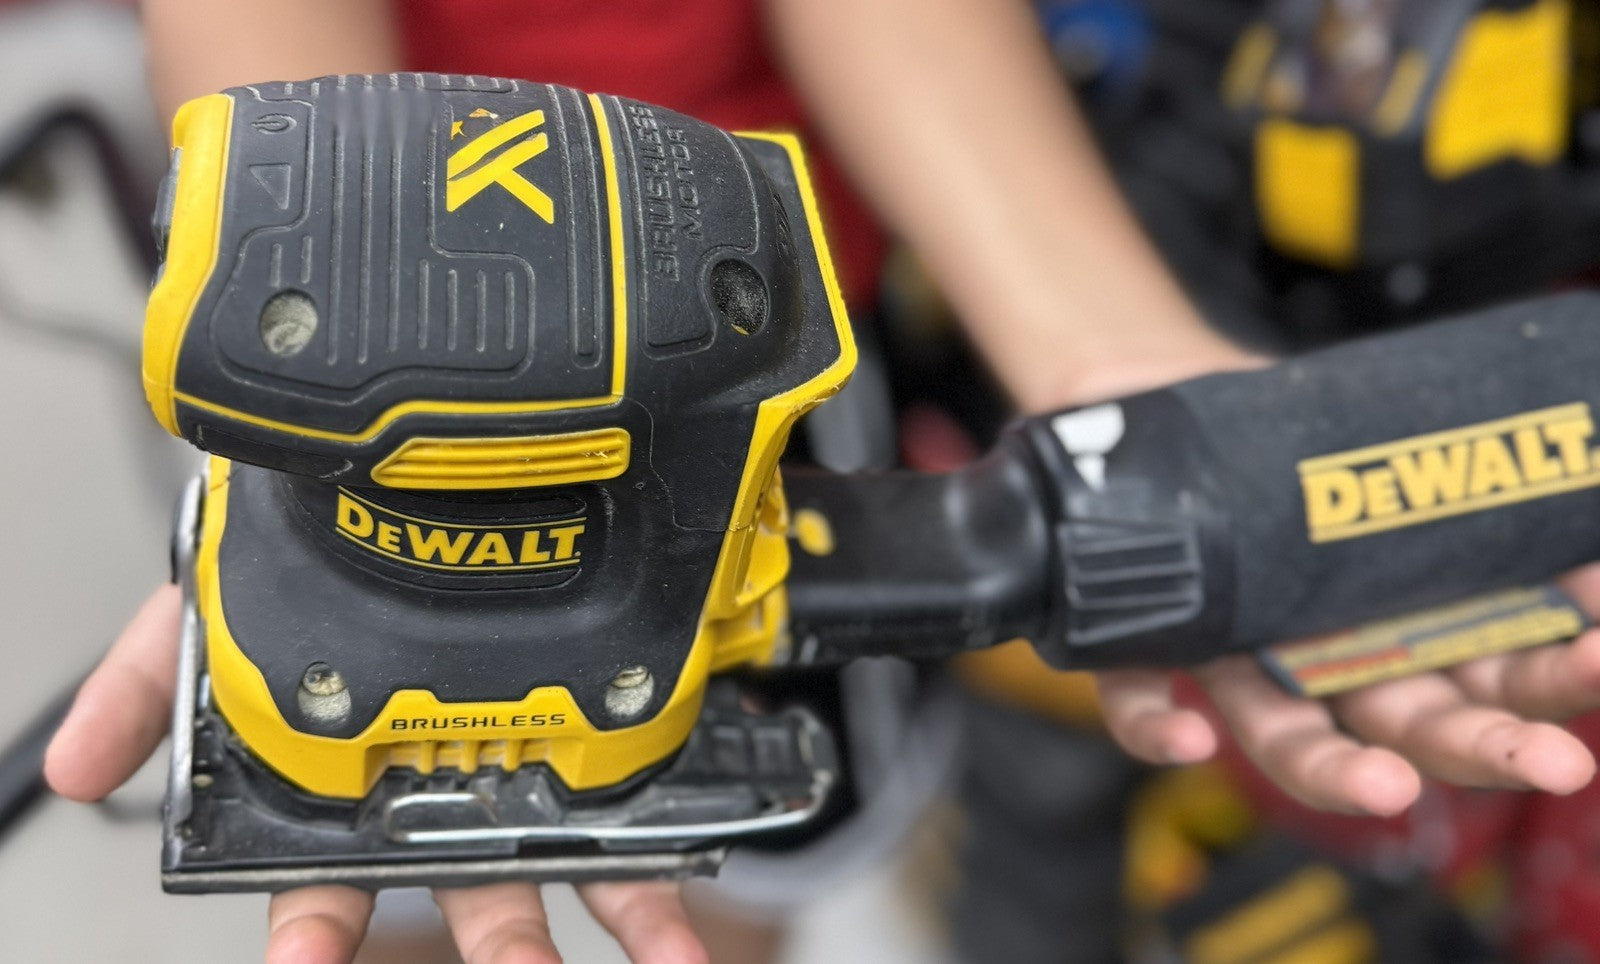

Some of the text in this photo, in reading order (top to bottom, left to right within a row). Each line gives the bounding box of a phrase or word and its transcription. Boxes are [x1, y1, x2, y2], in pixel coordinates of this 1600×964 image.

[629, 105, 680, 281] BRUSHLESS
[666, 128, 703, 240] MOTOR
[391, 713, 566, 731] BRUSHLESS
